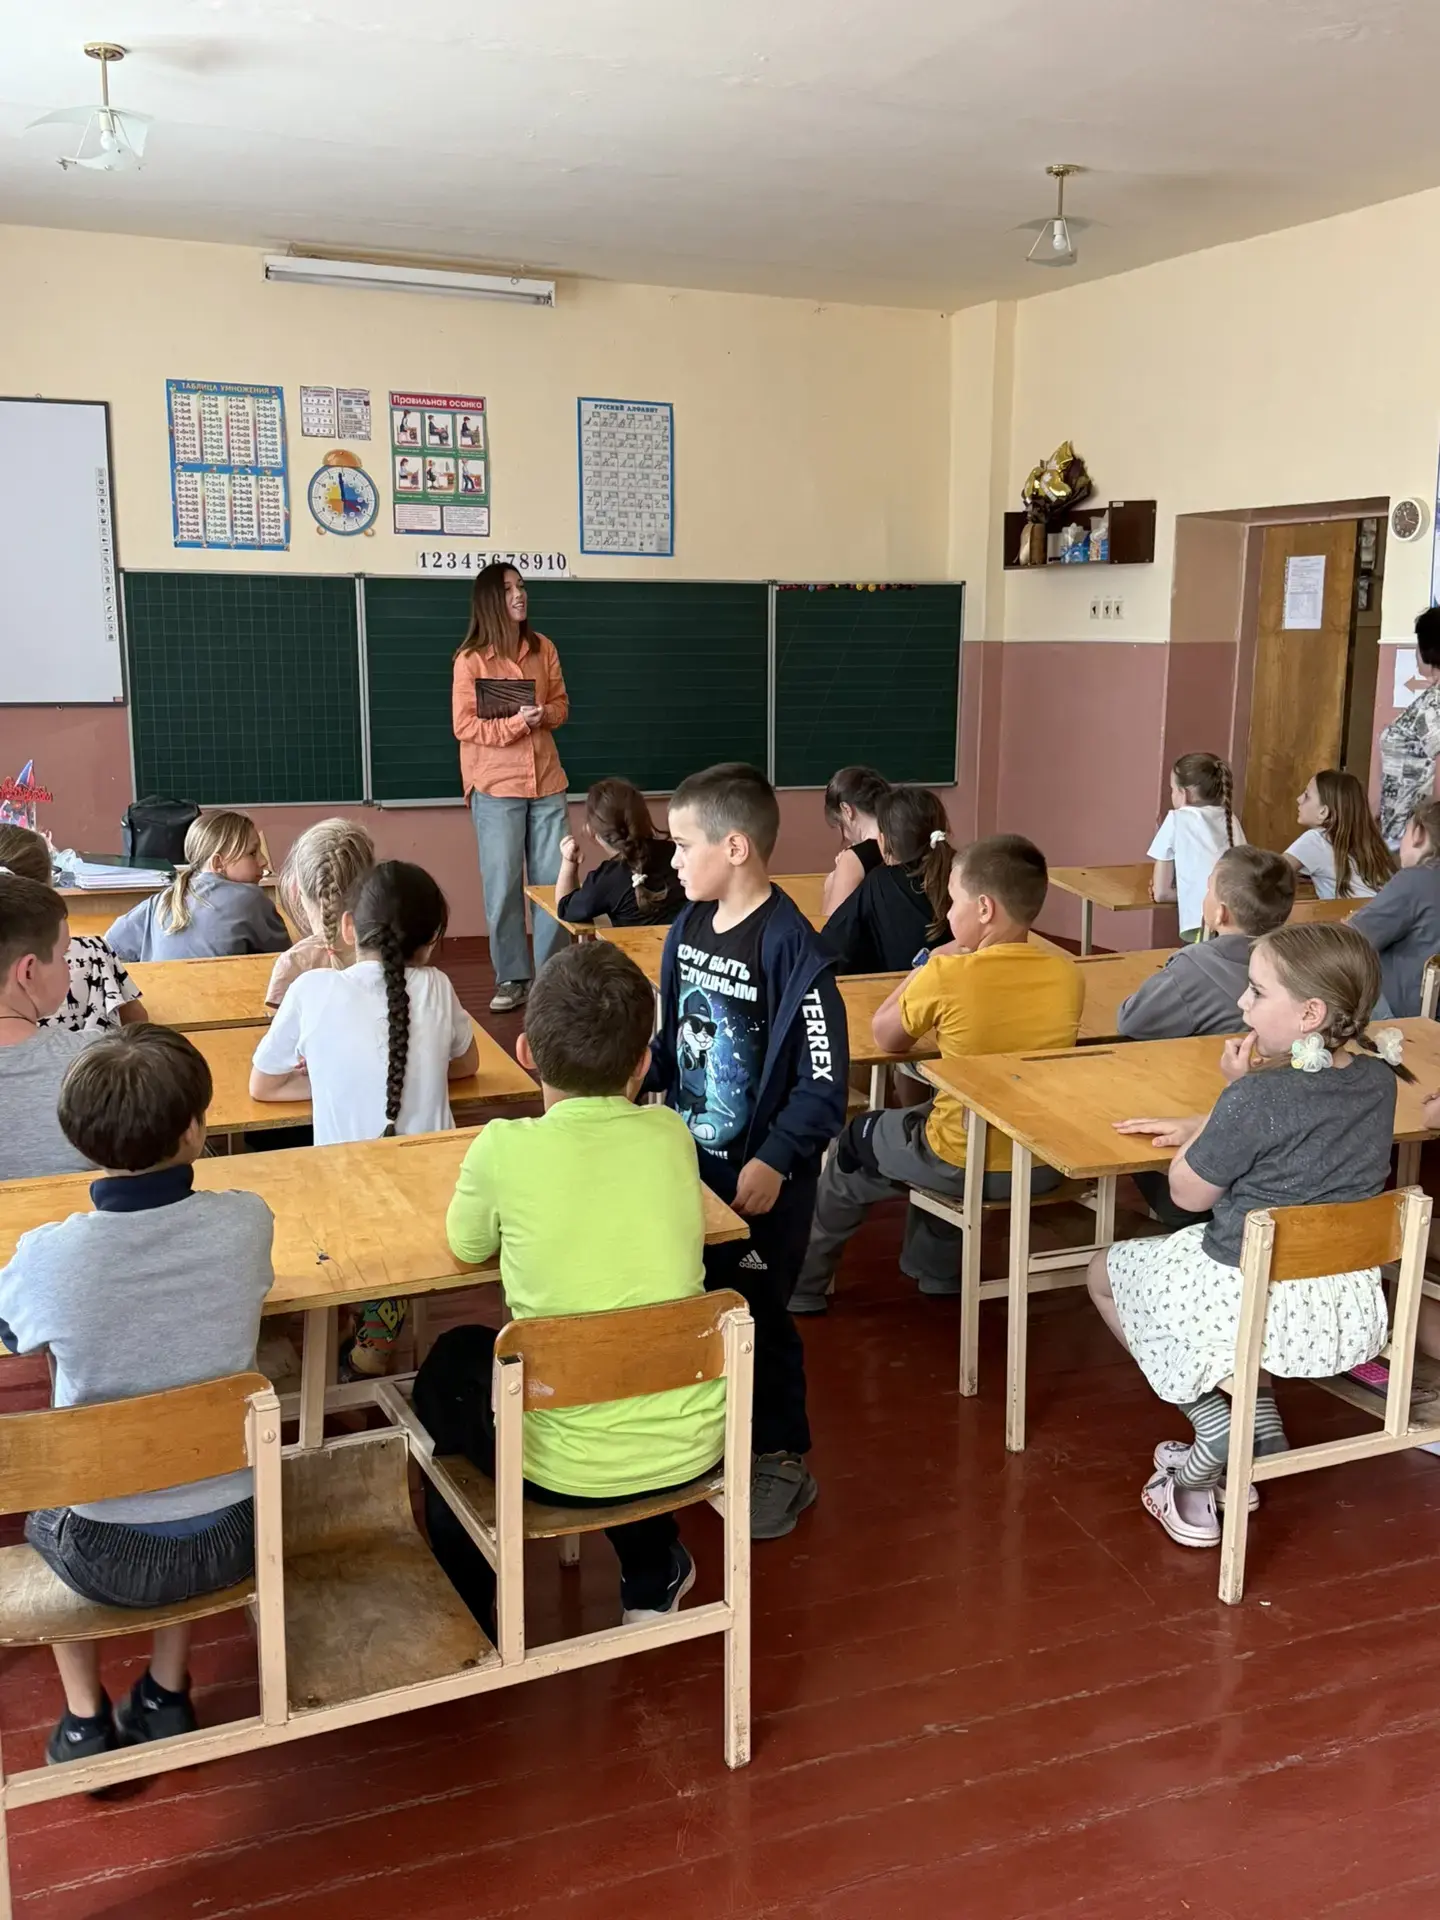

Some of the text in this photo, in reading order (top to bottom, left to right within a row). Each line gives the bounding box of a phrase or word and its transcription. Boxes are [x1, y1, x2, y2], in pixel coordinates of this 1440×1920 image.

[181, 382, 269, 395] ТАБЛИЦА УМНОЖЕНИЯ
[393, 395, 483, 409] Правильная осанка
[594, 403, 625, 411] РУССКИЙ
[420, 551, 428, 568] 1
[432, 551, 443, 568] 2
[446, 552, 457, 569] 3
[461, 553, 471, 569] 4
[476, 553, 487, 570] 5
[519, 553, 530, 570] 8
[533, 553, 543, 571] 9
[547, 553, 567, 571] 10
[708, 955, 751, 981] БЫТЬ
[802, 988, 834, 1083] TERREX
[738, 1260, 768, 1270] adidas
